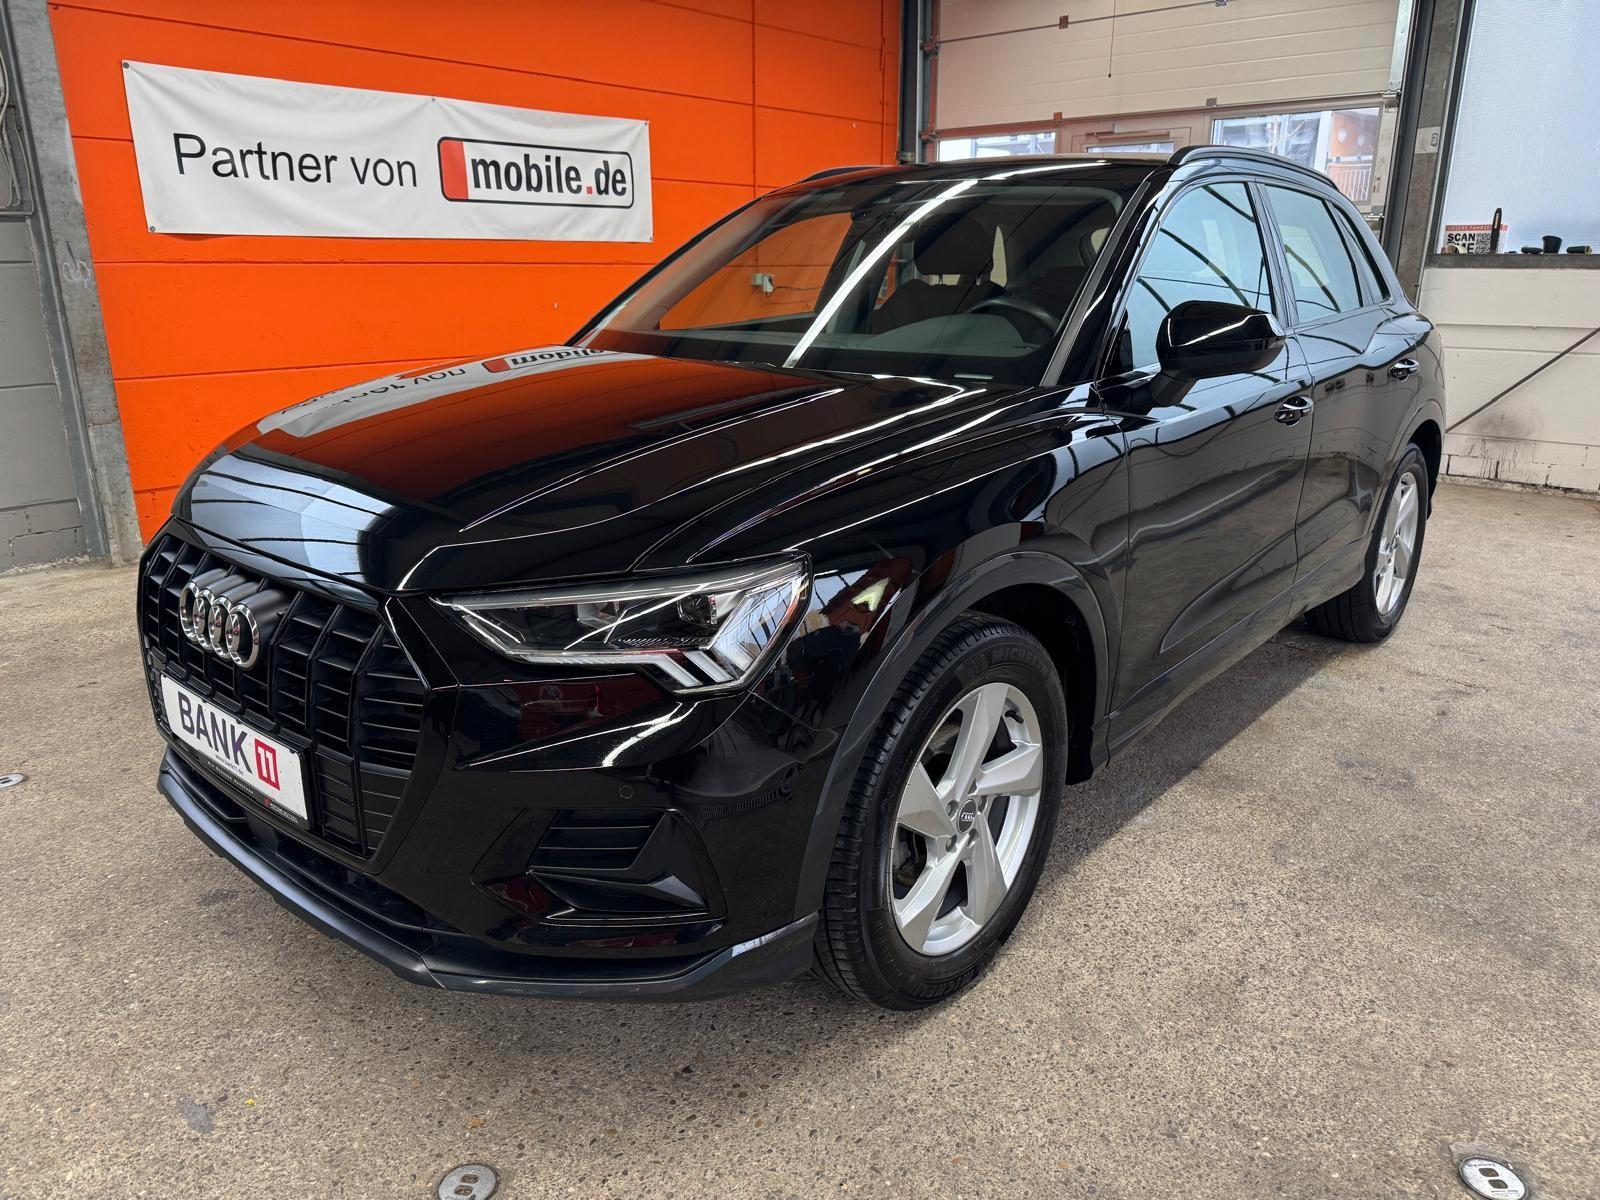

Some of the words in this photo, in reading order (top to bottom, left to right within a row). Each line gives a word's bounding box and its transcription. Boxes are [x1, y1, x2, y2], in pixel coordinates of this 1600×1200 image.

[172, 131, 338, 184] Partner
[350, 154, 418, 187] von
[471, 154, 628, 197] mobile.de
[1447, 233, 1475, 242] SCAN
[177, 690, 253, 774] BANK
